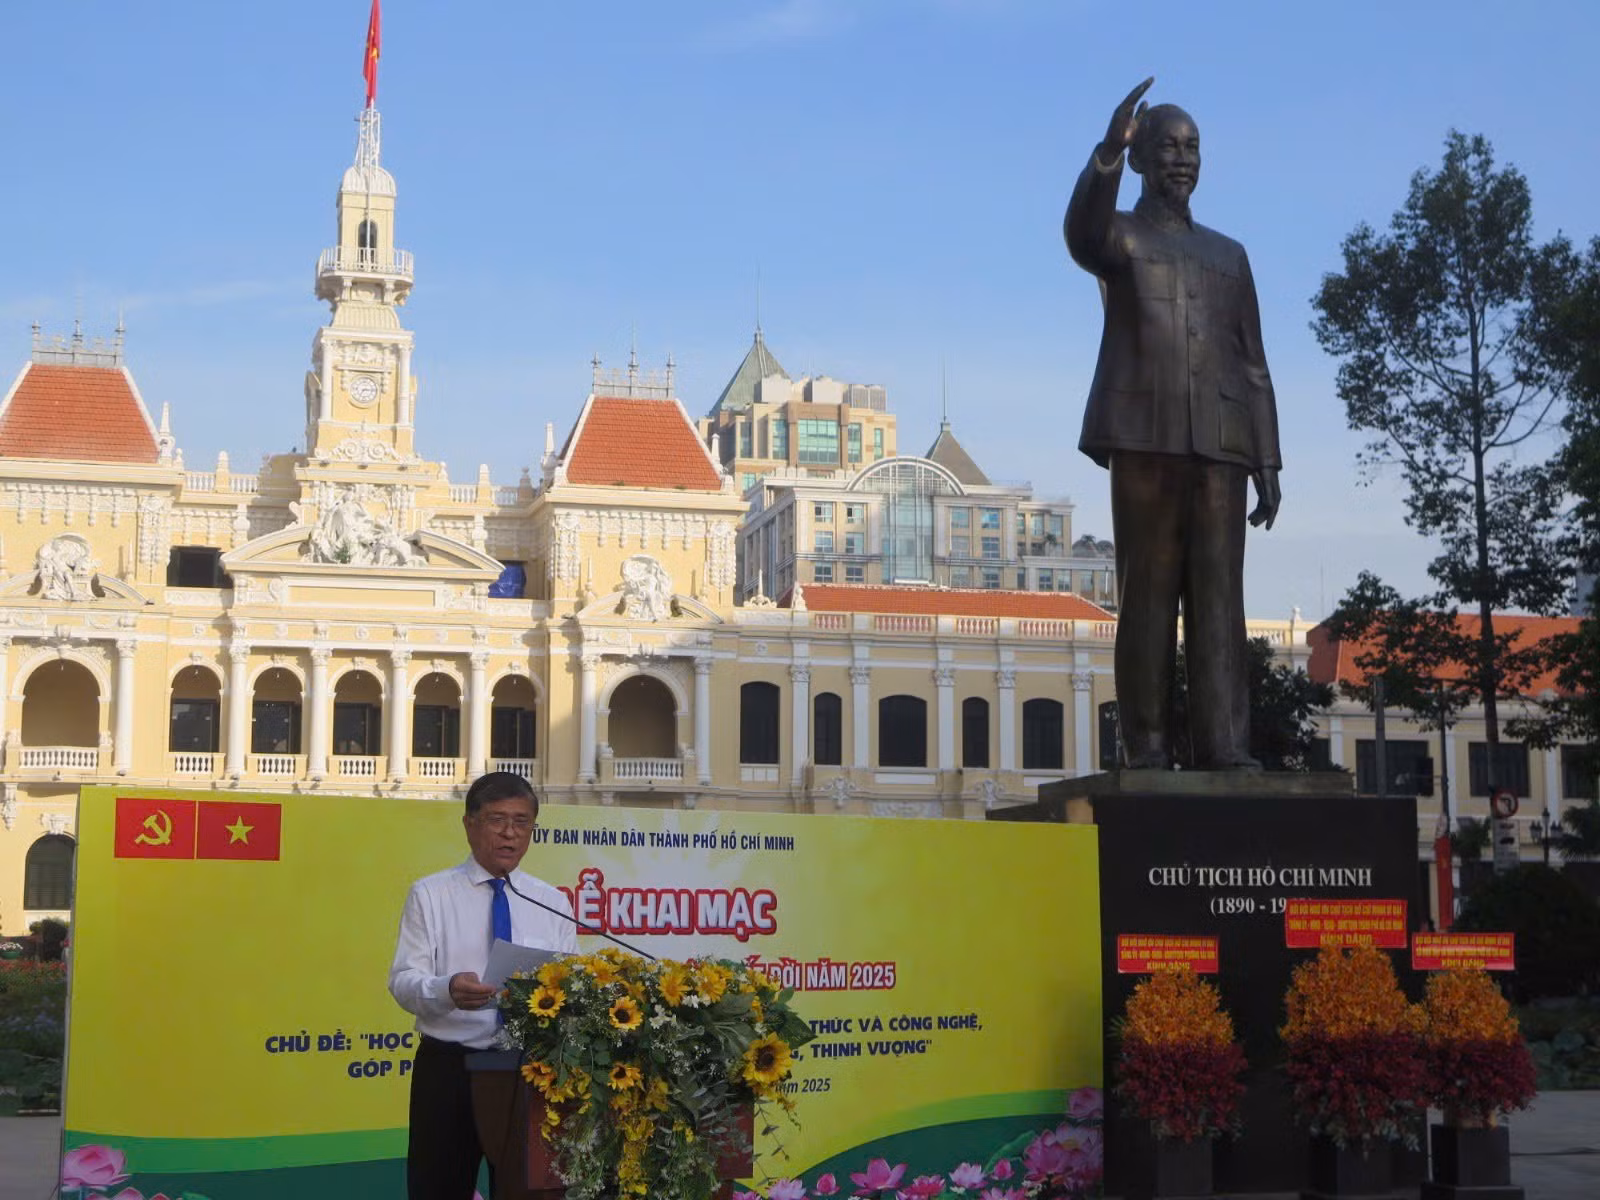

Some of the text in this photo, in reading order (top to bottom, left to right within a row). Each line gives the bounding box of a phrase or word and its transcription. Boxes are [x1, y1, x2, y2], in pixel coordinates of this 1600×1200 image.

[554, 829, 579, 845] BAN
[583, 827, 617, 846] NHÂN
[621, 828, 645, 847] DÂN
[649, 829, 689, 849] THÀNH
[693, 829, 718, 849] PHỐ
[721, 830, 737, 850] HỒ
[741, 832, 761, 850] CHÍ
[764, 836, 794, 851] MINH
[1149, 863, 1191, 887] CHỦ
[1195, 867, 1243, 889] TỊCH
[1279, 864, 1315, 887] CHÍ
[1319, 867, 1373, 887] MINH
[574, 868, 775, 939] Ễ KHAI MẠC
[1210, 897, 1255, 916] (1890
[806, 959, 847, 989] NĂM
[851, 963, 896, 988] 2025
[809, 1013, 983, 1034] THỨC VÀ CÔNG NGHỆ,
[265, 1029, 413, 1053] CHỦ ĐỀ: "HỌC
[810, 1041, 861, 1060] THỊNH
[867, 1039, 932, 1057] VƯỢNG"
[348, 1058, 392, 1078] GÓP
[802, 1078, 831, 1093] 2025
